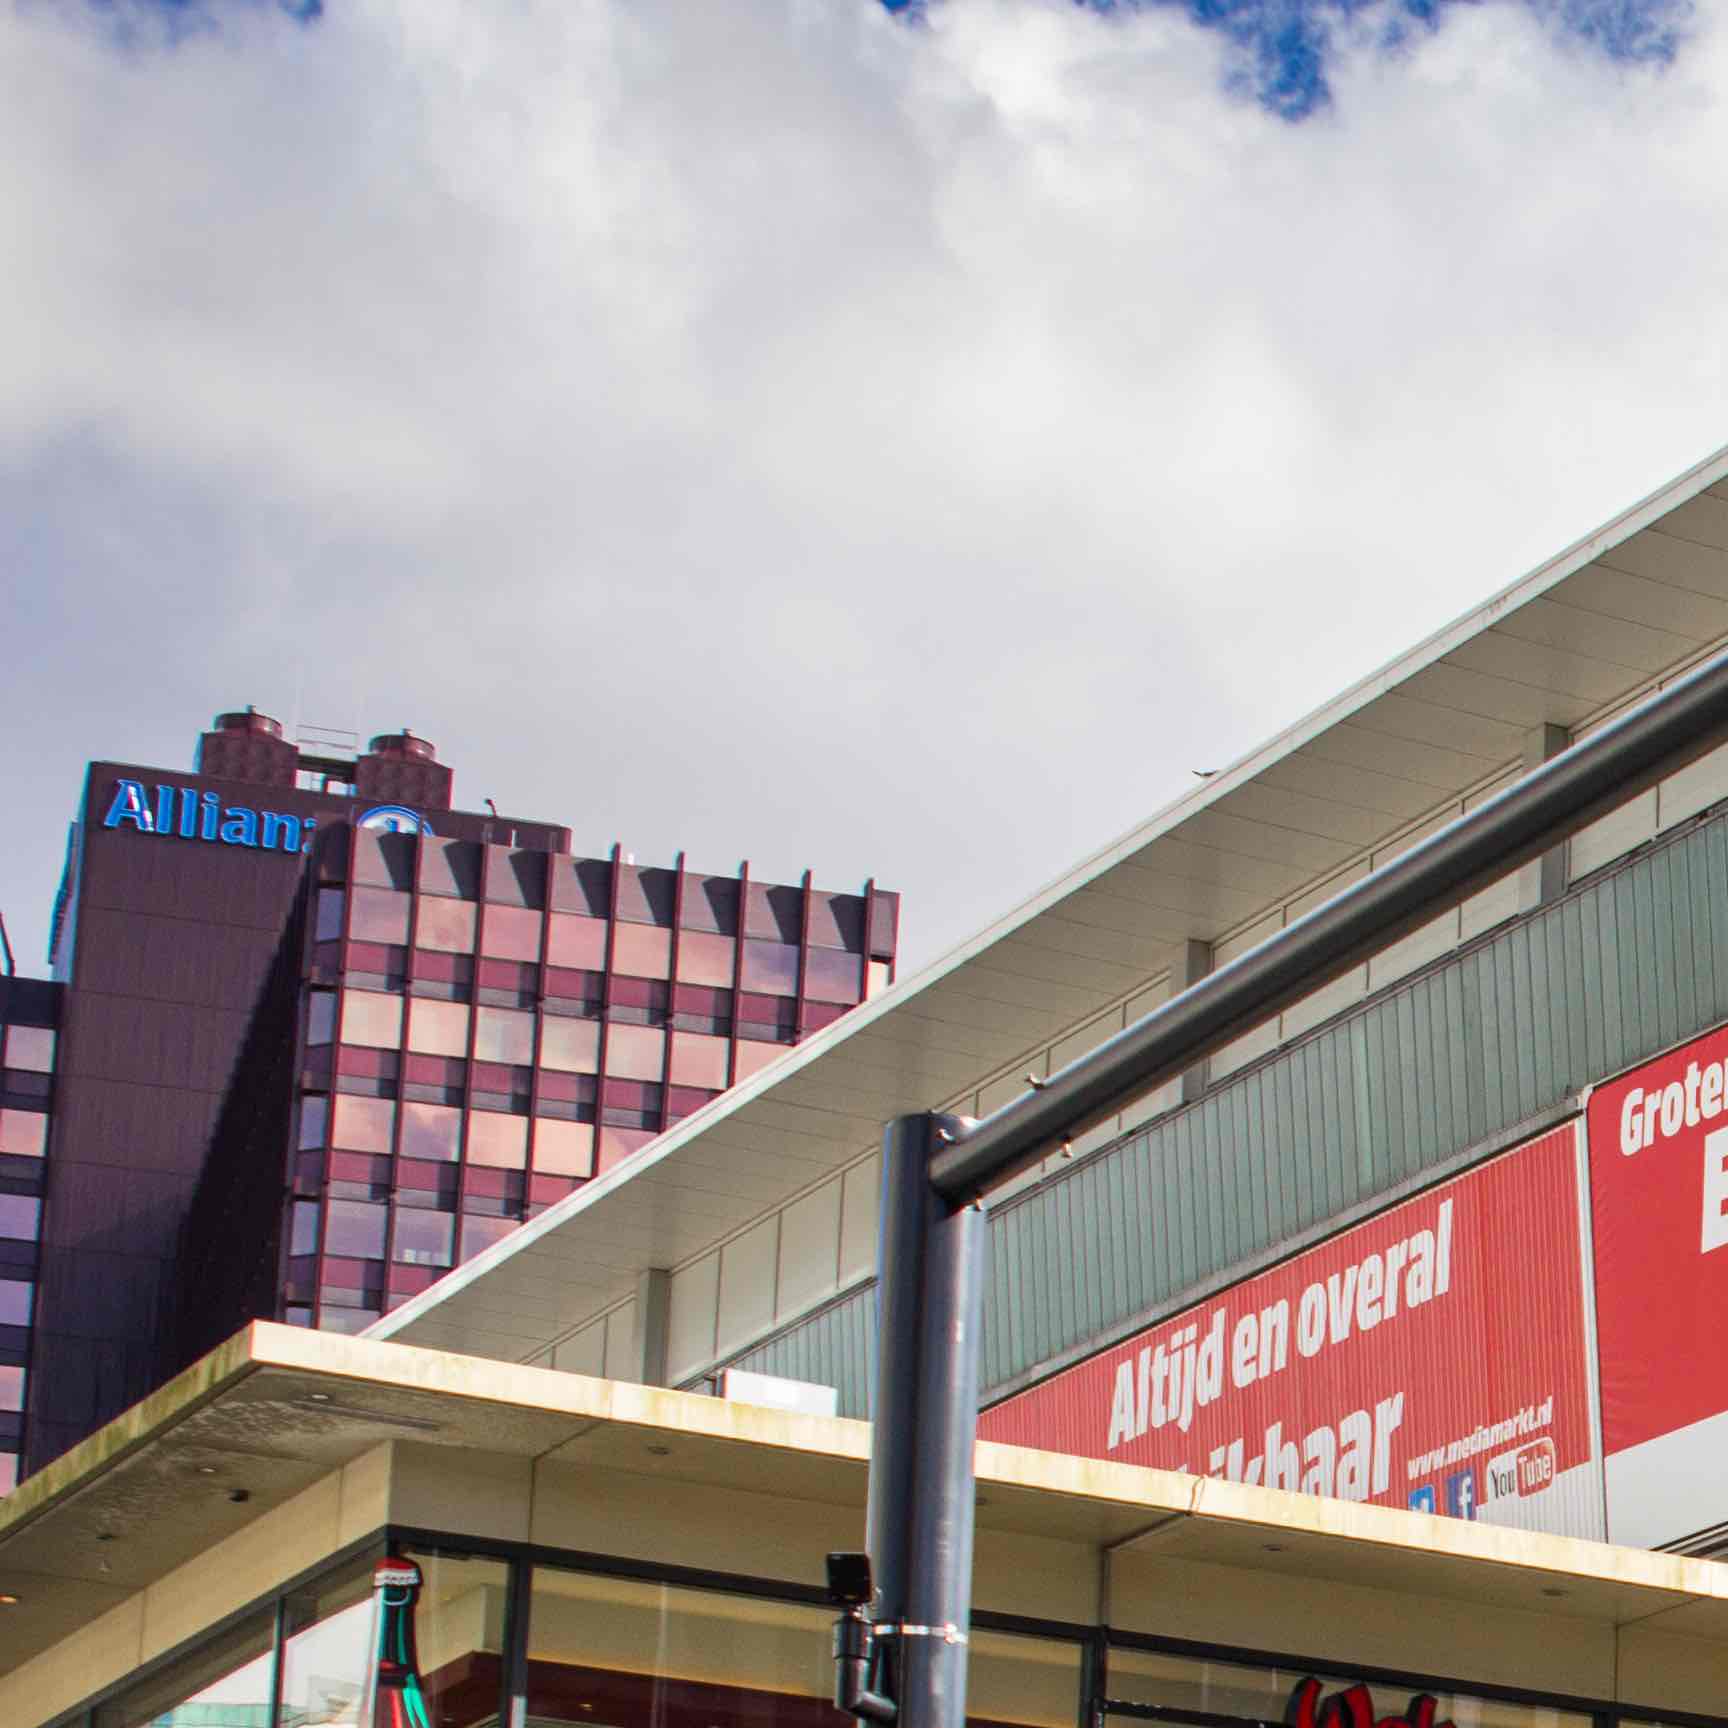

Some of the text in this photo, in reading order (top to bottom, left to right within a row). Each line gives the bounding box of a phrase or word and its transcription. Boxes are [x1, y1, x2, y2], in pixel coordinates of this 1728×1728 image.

[1107, 1198, 1453, 1450] Altijd en overal
[1408, 1396, 1553, 1480] www.mediamarkt.nl
